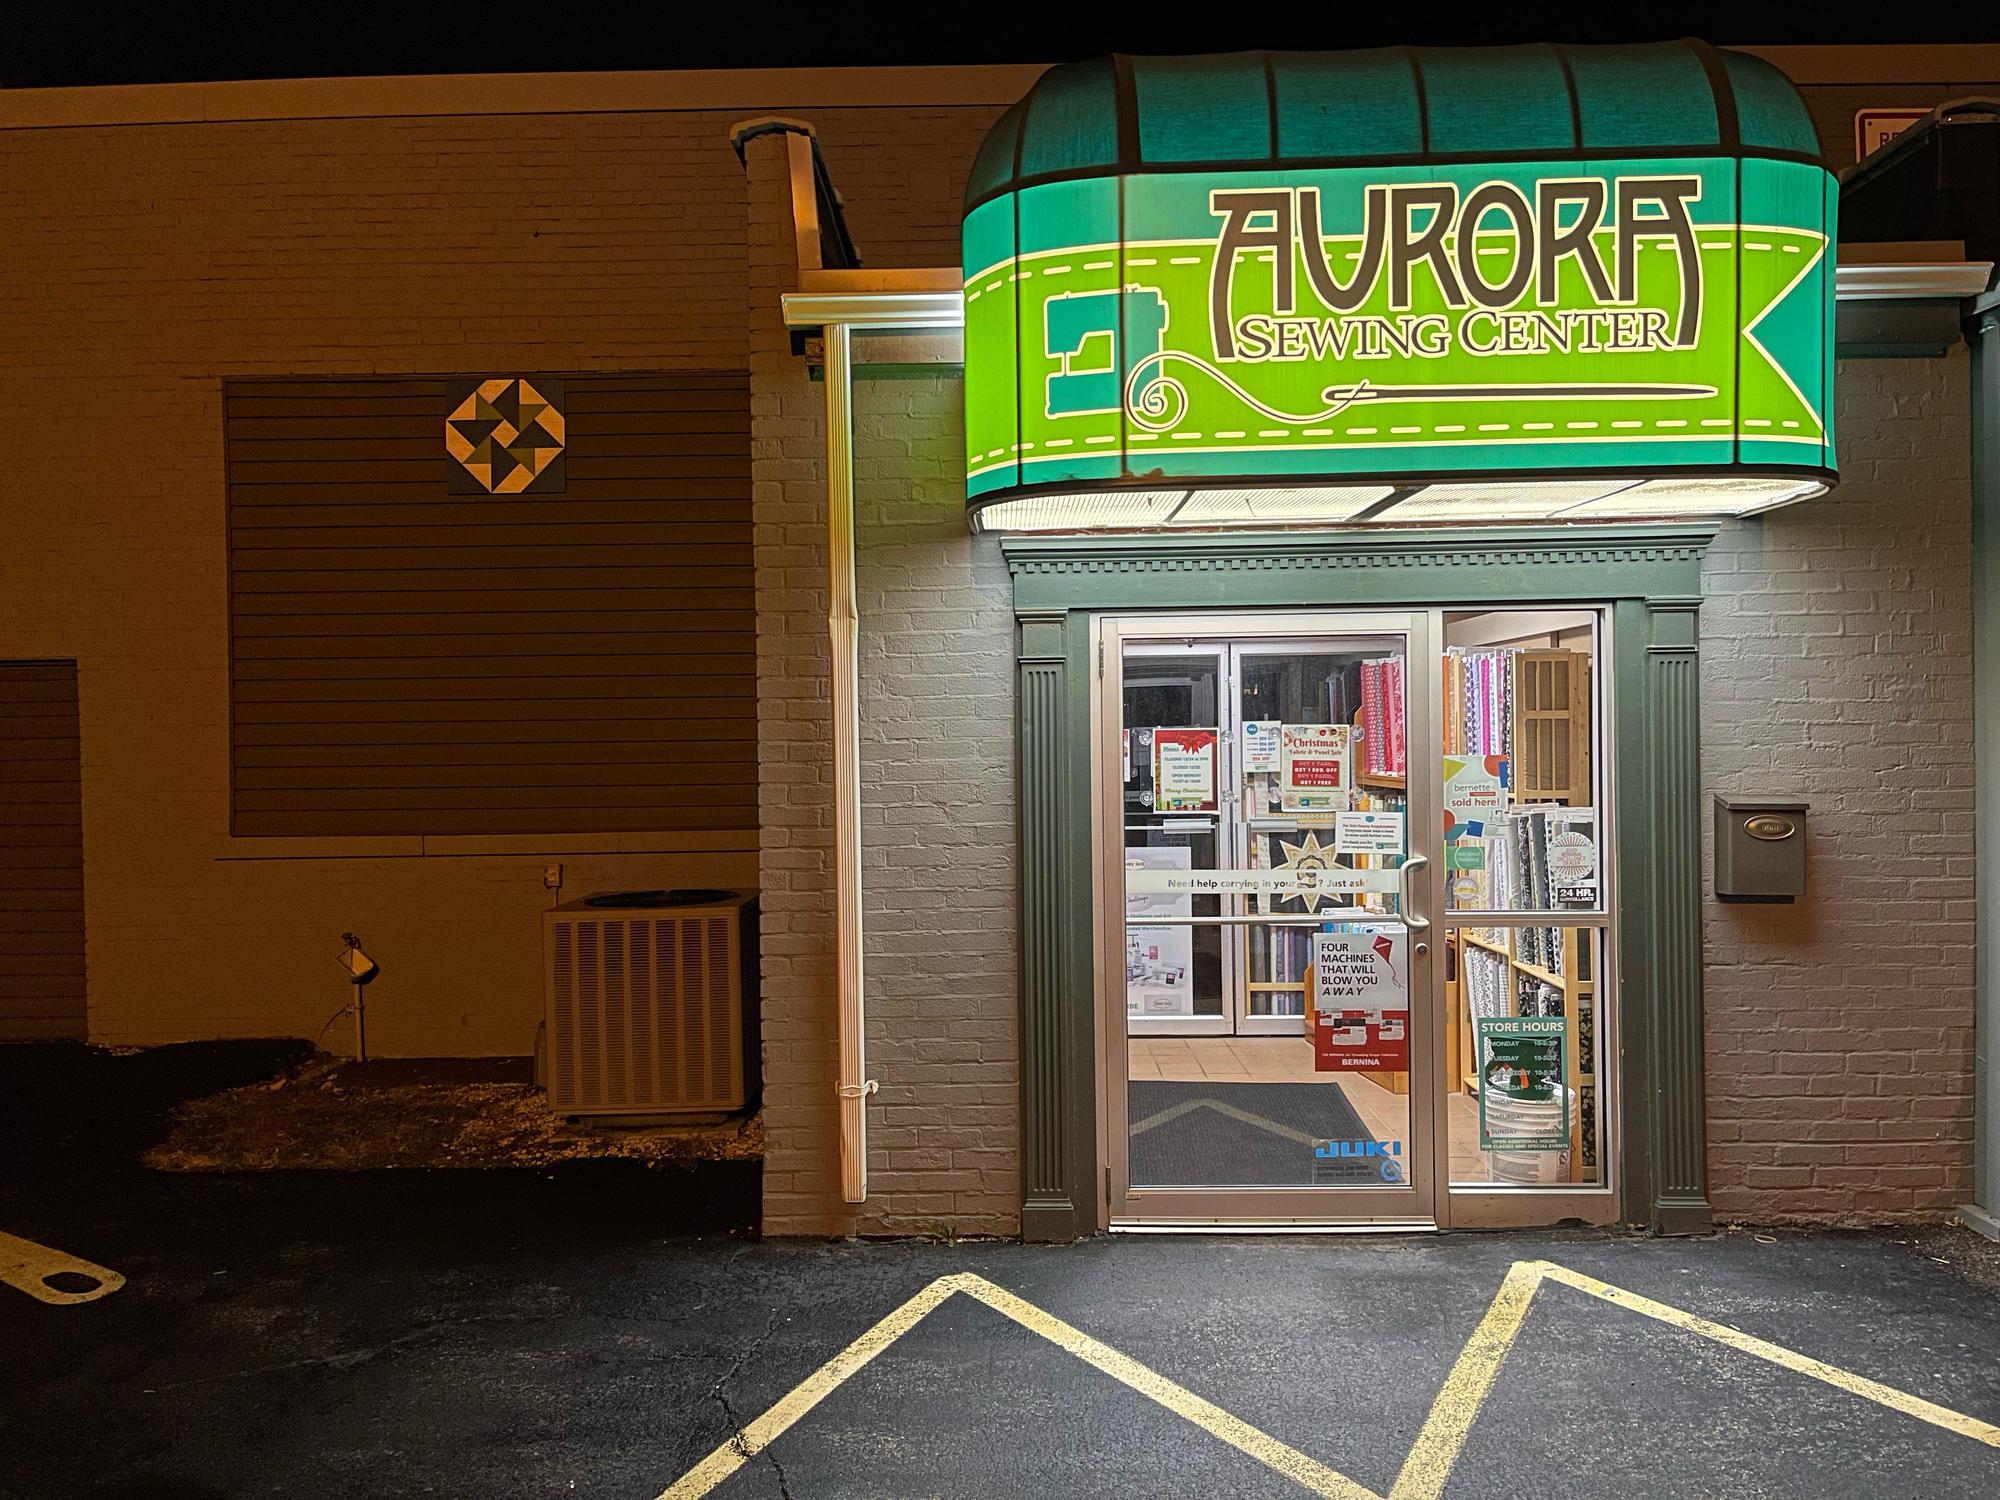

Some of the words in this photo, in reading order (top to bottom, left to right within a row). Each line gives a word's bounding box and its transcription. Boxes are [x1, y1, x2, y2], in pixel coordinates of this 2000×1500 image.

[1210, 176, 1701, 361] AURORA
[1236, 316, 1451, 360] SEWING
[1460, 309, 1675, 352] CENTER
[1293, 738, 1339, 748] Christmas
[1451, 798, 1472, 807] sold
[1474, 798, 1500, 806] here!
[1168, 879, 1194, 888] Need
[1197, 879, 1218, 889] help
[1221, 879, 1259, 890] carrying
[1262, 879, 1271, 888] in
[1273, 881, 1297, 890] your
[1327, 879, 1346, 888] Just
[1349, 879, 1369, 888] ask!
[1559, 888, 1574, 897] 24
[1576, 888, 1595, 897] HR.
[1321, 943, 1349, 952] FOUR
[1321, 953, 1375, 963] MACHINES
[1321, 965, 1348, 974] THAT
[1350, 965, 1375, 974] WILL
[1321, 976, 1352, 985] BLOW
[1355, 976, 1378, 985] YOU
[1322, 987, 1364, 996] AWAY
[1481, 1022, 1519, 1032] STORE
[1522, 1022, 1564, 1032] HOURS
[1341, 1058, 1380, 1066] BERNINA
[1315, 1140, 1401, 1158] JUKI
